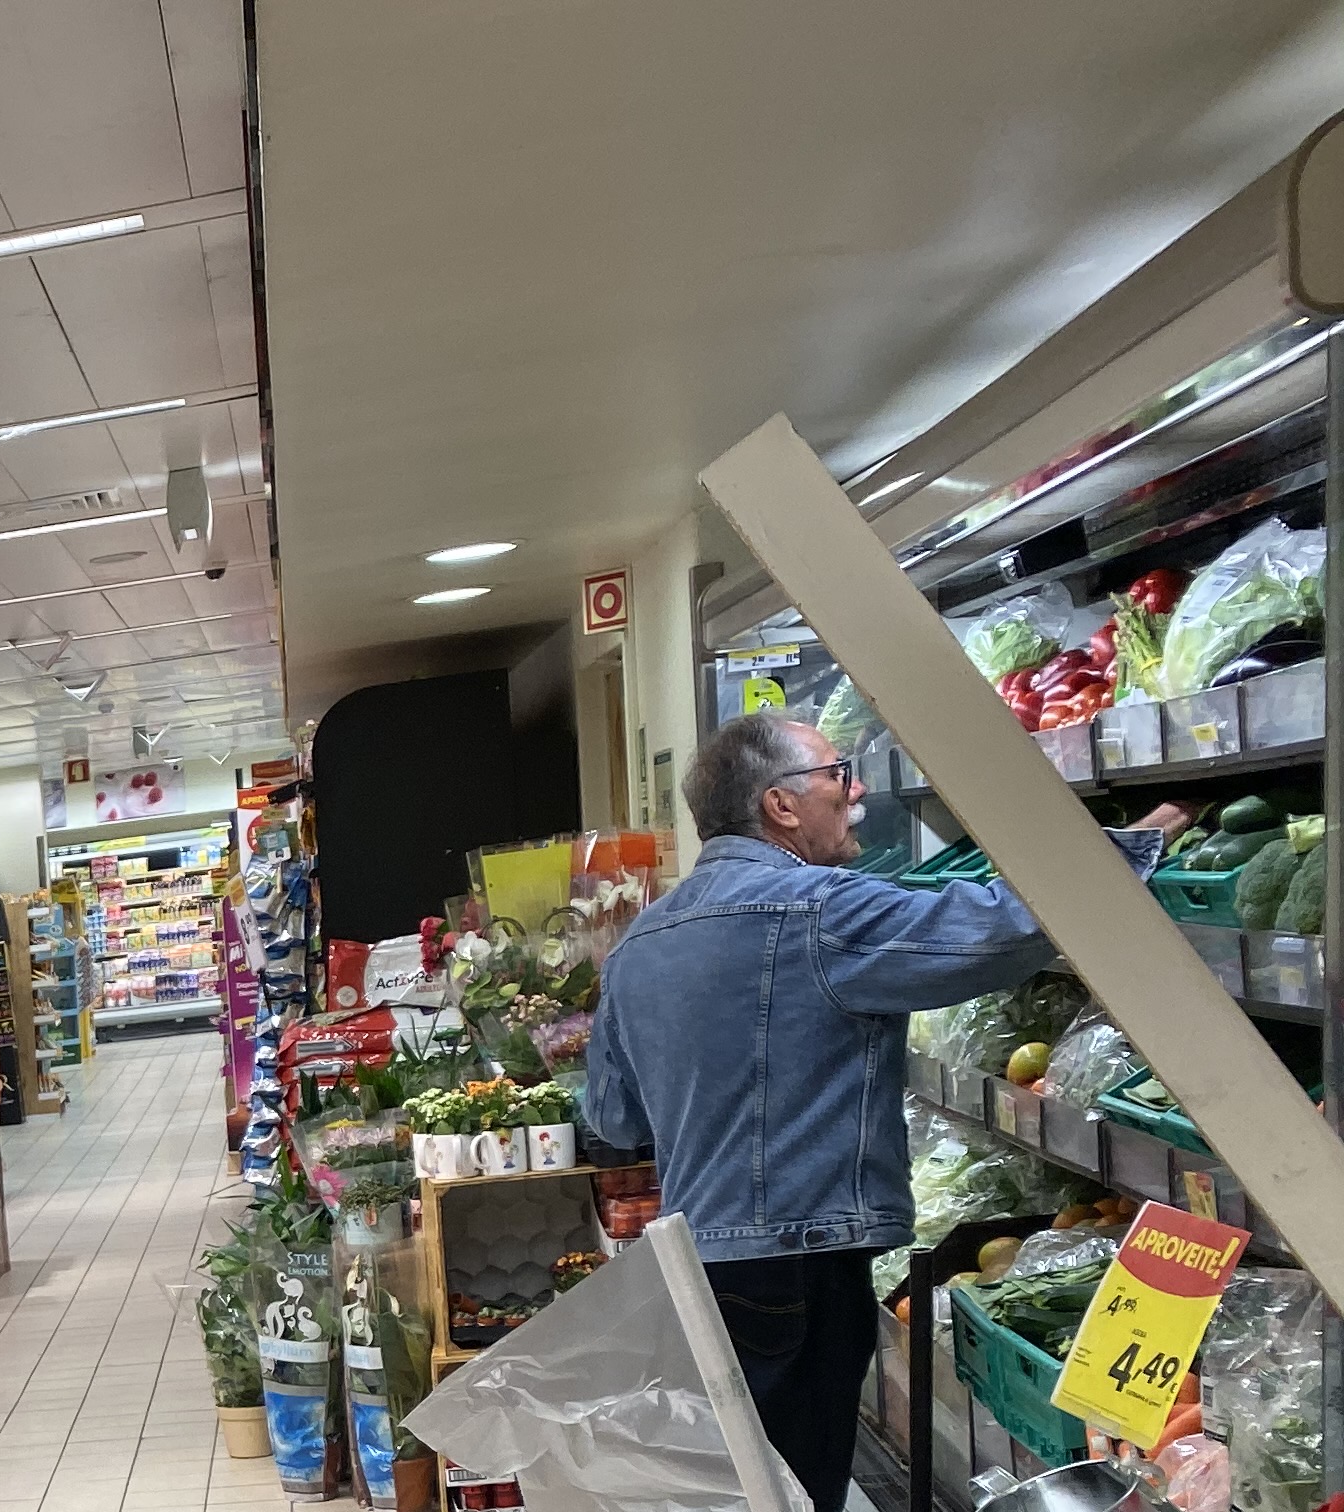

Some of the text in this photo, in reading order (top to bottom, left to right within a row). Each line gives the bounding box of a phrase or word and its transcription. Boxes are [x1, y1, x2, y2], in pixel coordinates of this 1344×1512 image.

[287, 1252, 328, 1265] STYLE
[1130, 1227, 1241, 1280] APROVEITE!
[287, 1268, 329, 1276] EMOTION
[1108, 1342, 1180, 1392] 4,49
